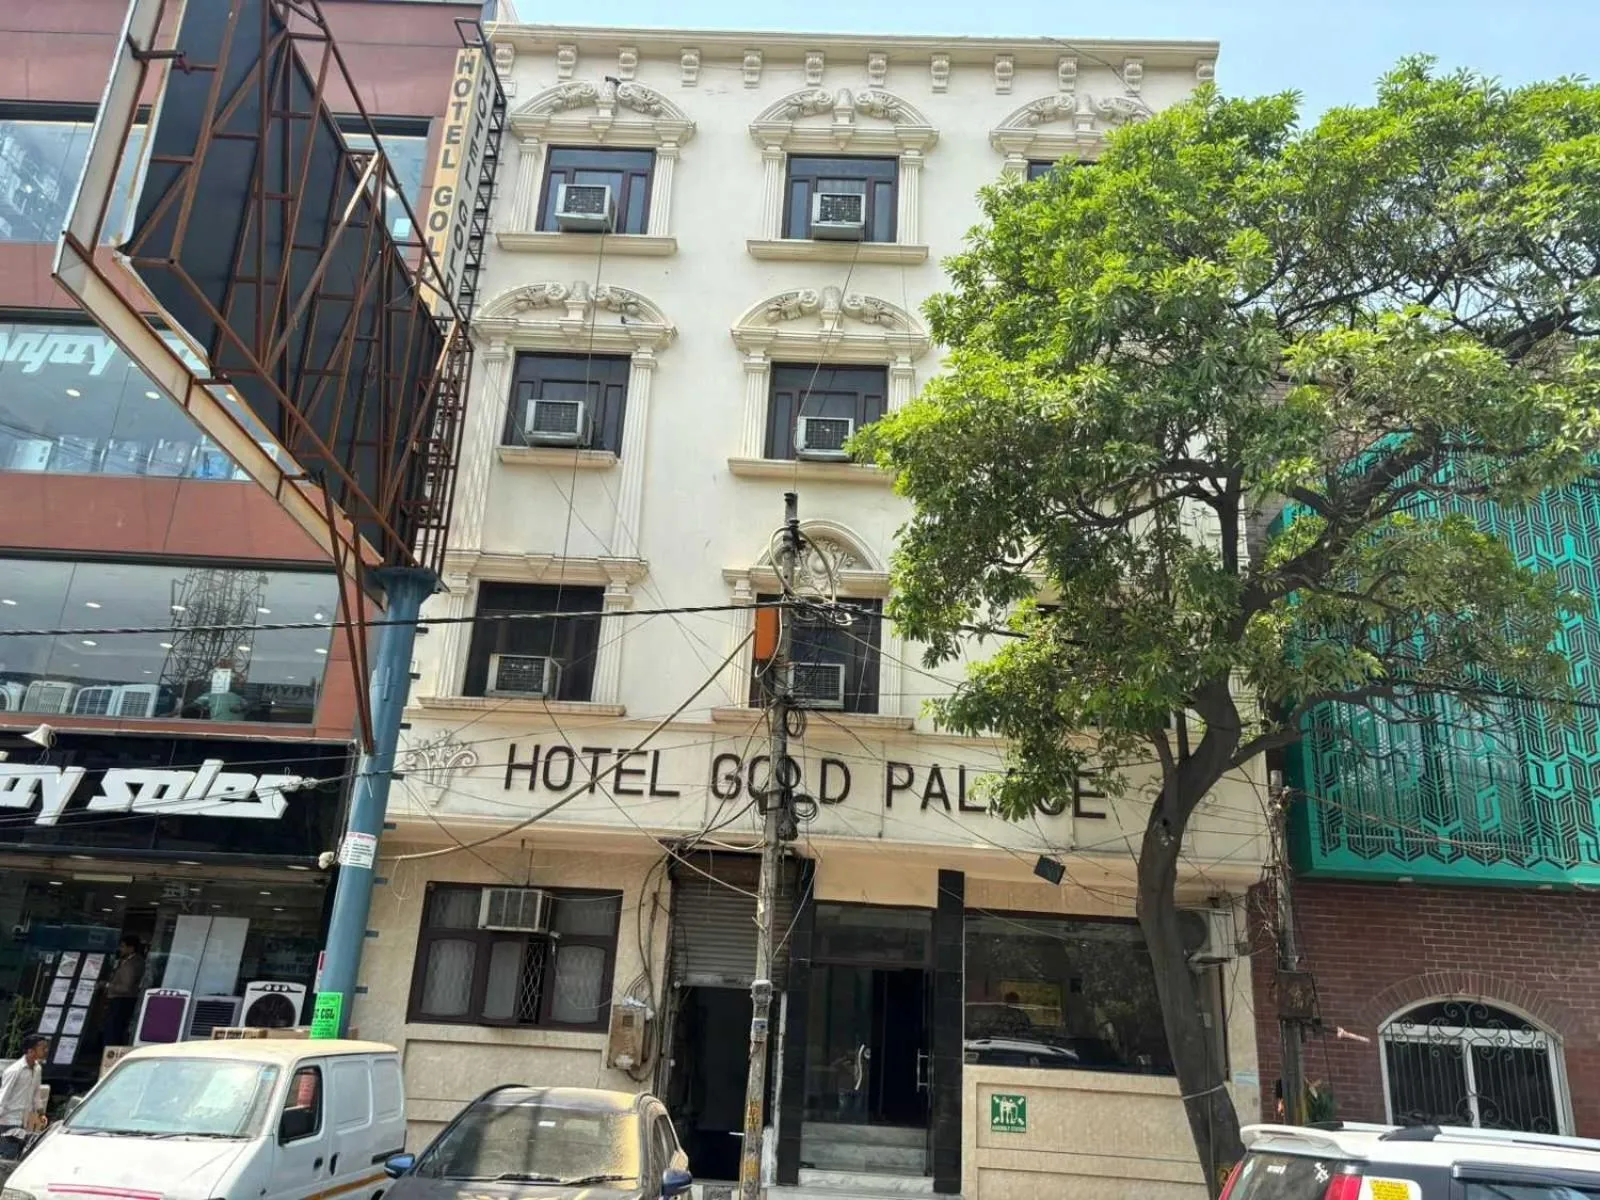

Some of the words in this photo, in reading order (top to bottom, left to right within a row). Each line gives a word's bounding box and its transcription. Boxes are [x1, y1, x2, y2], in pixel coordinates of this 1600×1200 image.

[441, 55, 476, 169] HOTEL
[465, 66, 491, 191] HOTEL
[504, 743, 680, 797] HOTEL
[711, 753, 851, 804] GOD
[886, 761, 1107, 819] PALE
